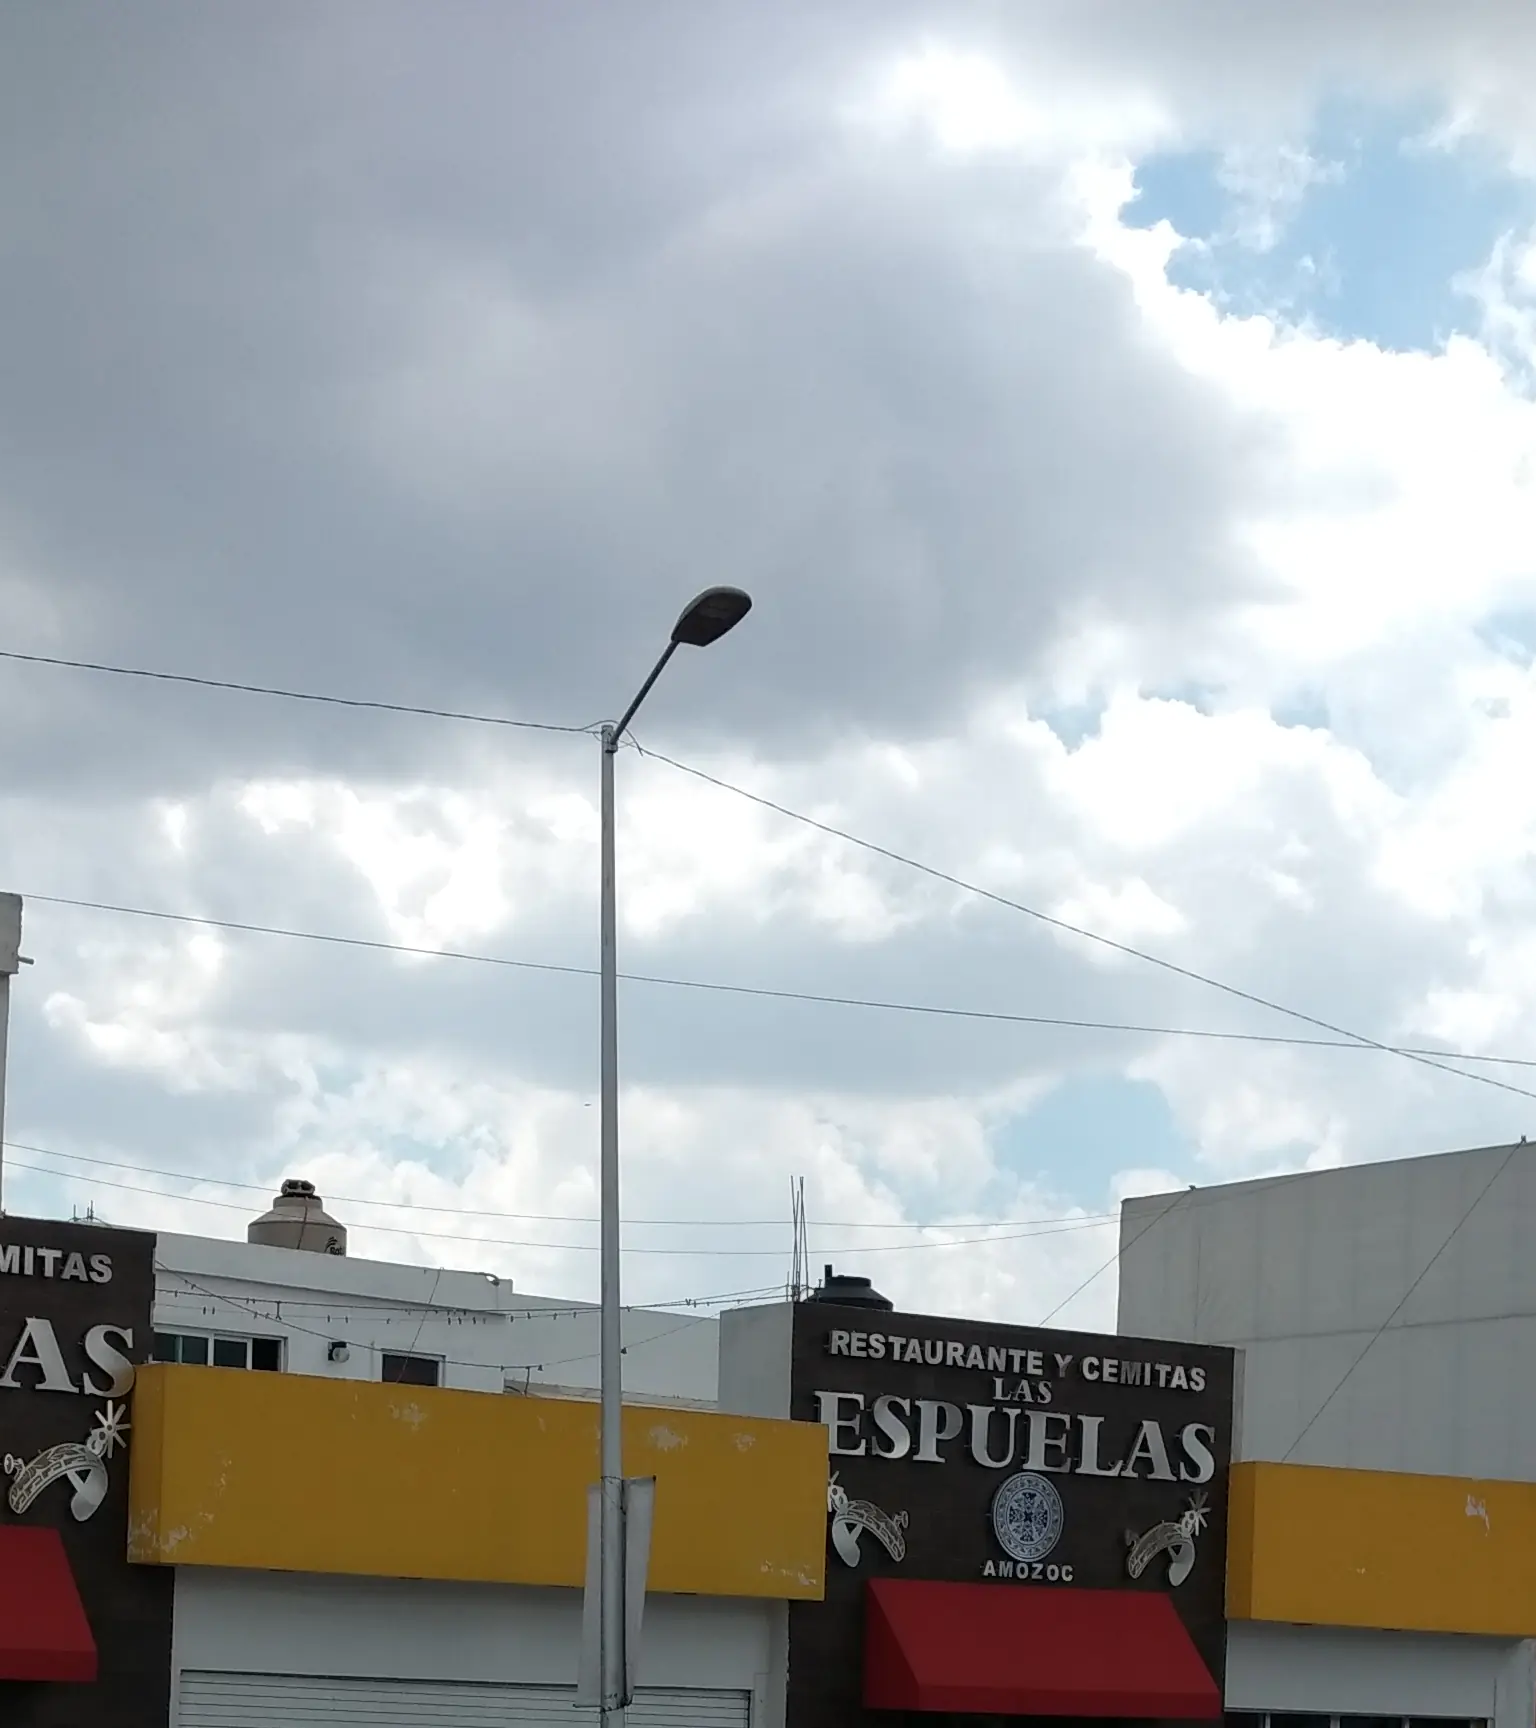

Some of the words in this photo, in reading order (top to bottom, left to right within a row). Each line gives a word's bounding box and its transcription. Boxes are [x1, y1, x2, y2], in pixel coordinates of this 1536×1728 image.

[828, 1328, 1045, 1377] RESTAURANTE
[1053, 1353, 1076, 1379] Y
[1081, 1355, 1208, 1393] CEMITAS
[992, 1375, 1053, 1404] LAS
[814, 1389, 1216, 1485] ESPUELAS
[982, 1559, 1075, 1582] AMOZOC
